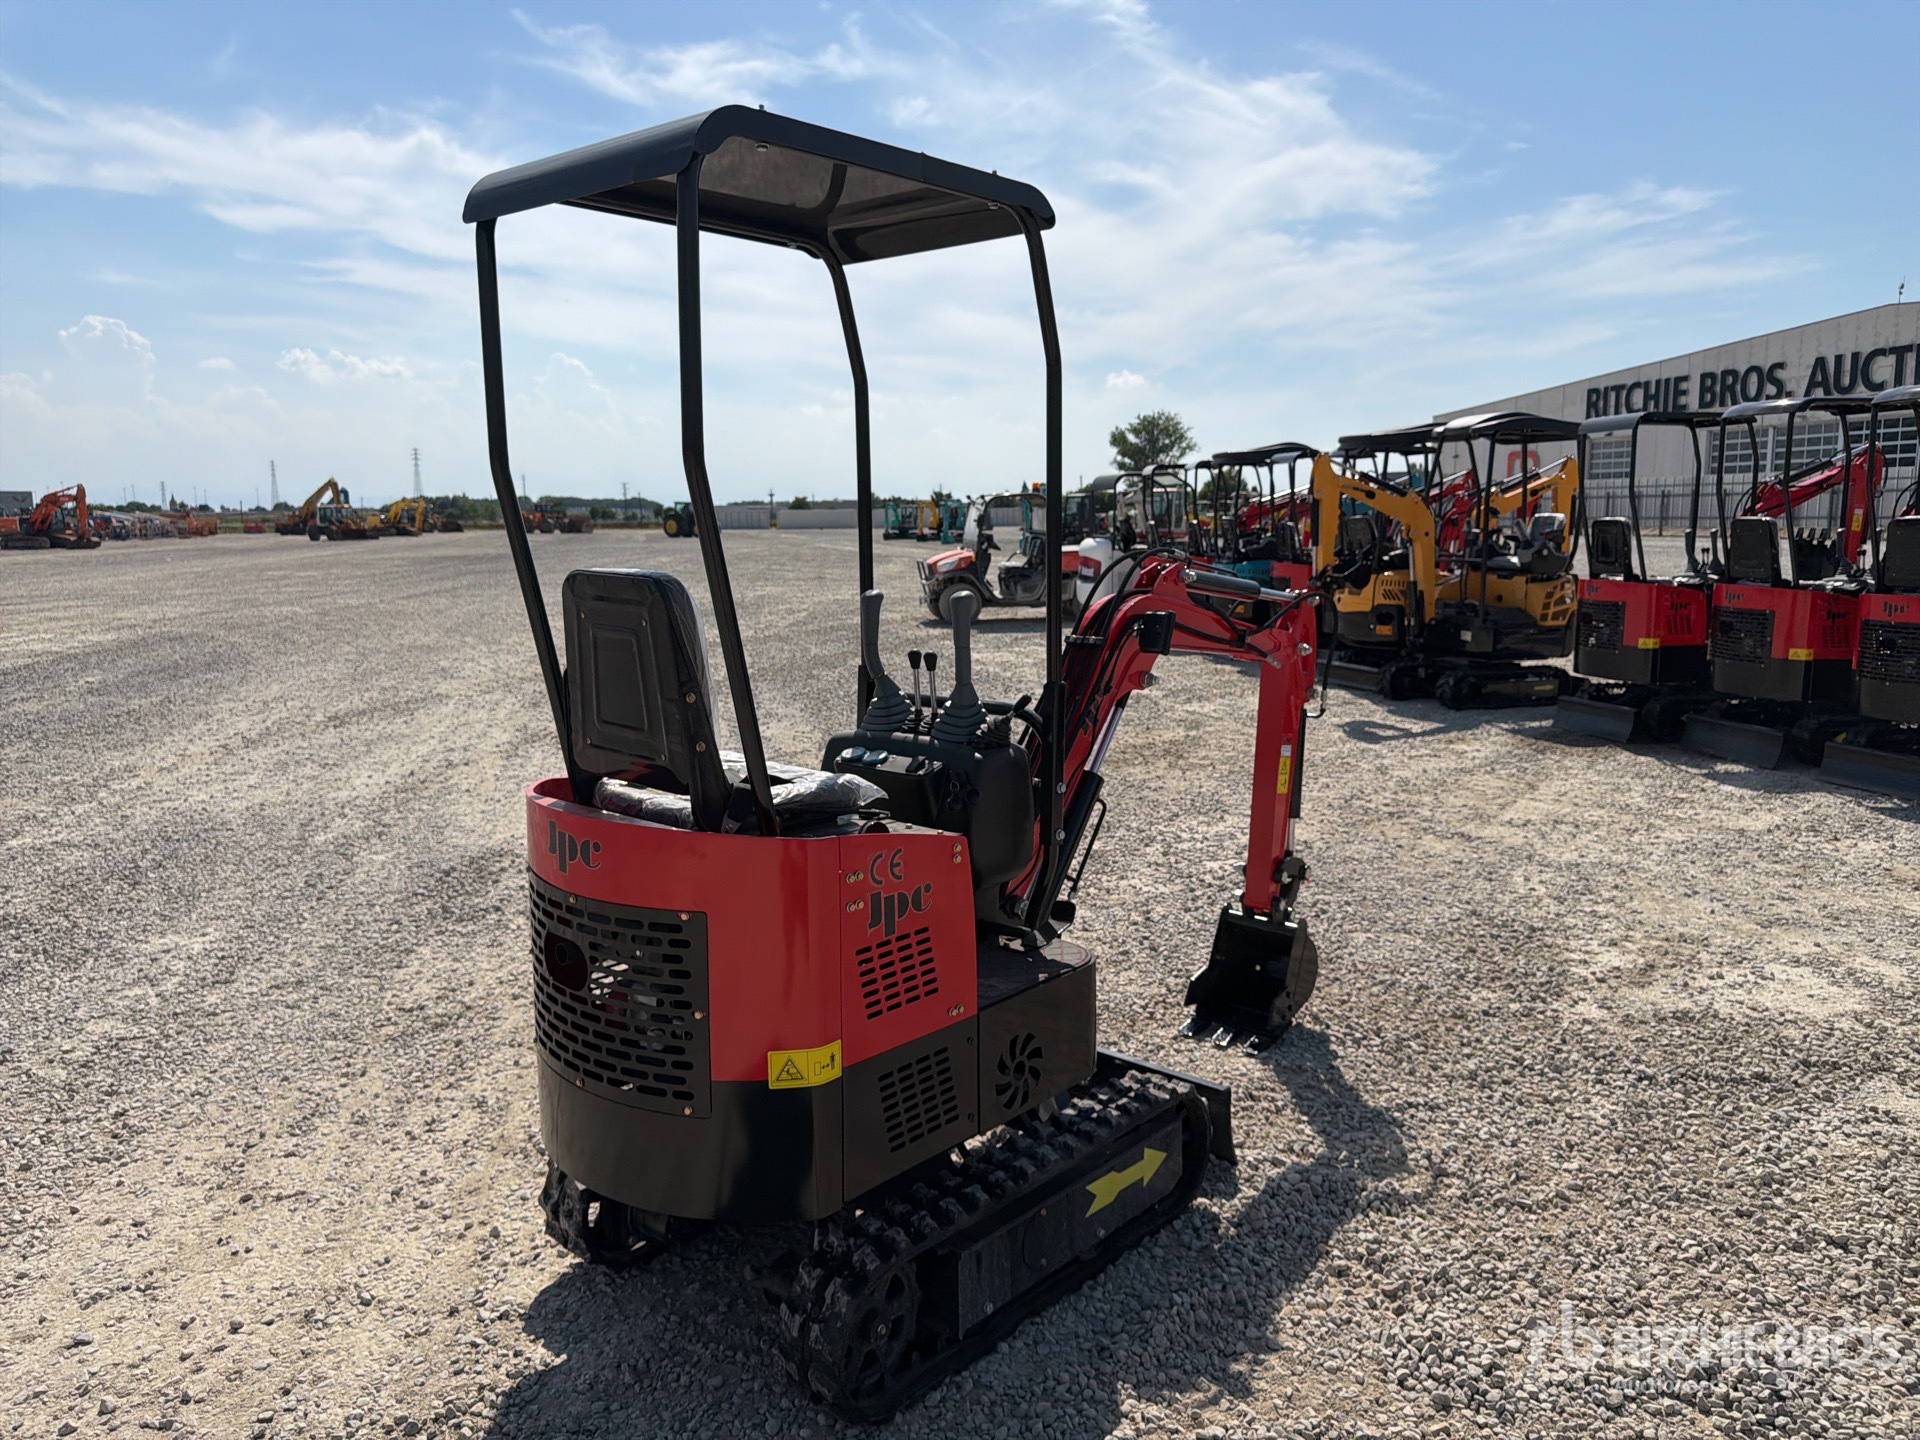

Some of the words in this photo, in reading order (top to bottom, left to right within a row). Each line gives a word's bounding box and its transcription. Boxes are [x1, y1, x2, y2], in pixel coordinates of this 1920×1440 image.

[1586, 375, 1689, 419] RITCHIE
[1699, 361, 1794, 409] BROS.
[869, 846, 903, 886] CE
